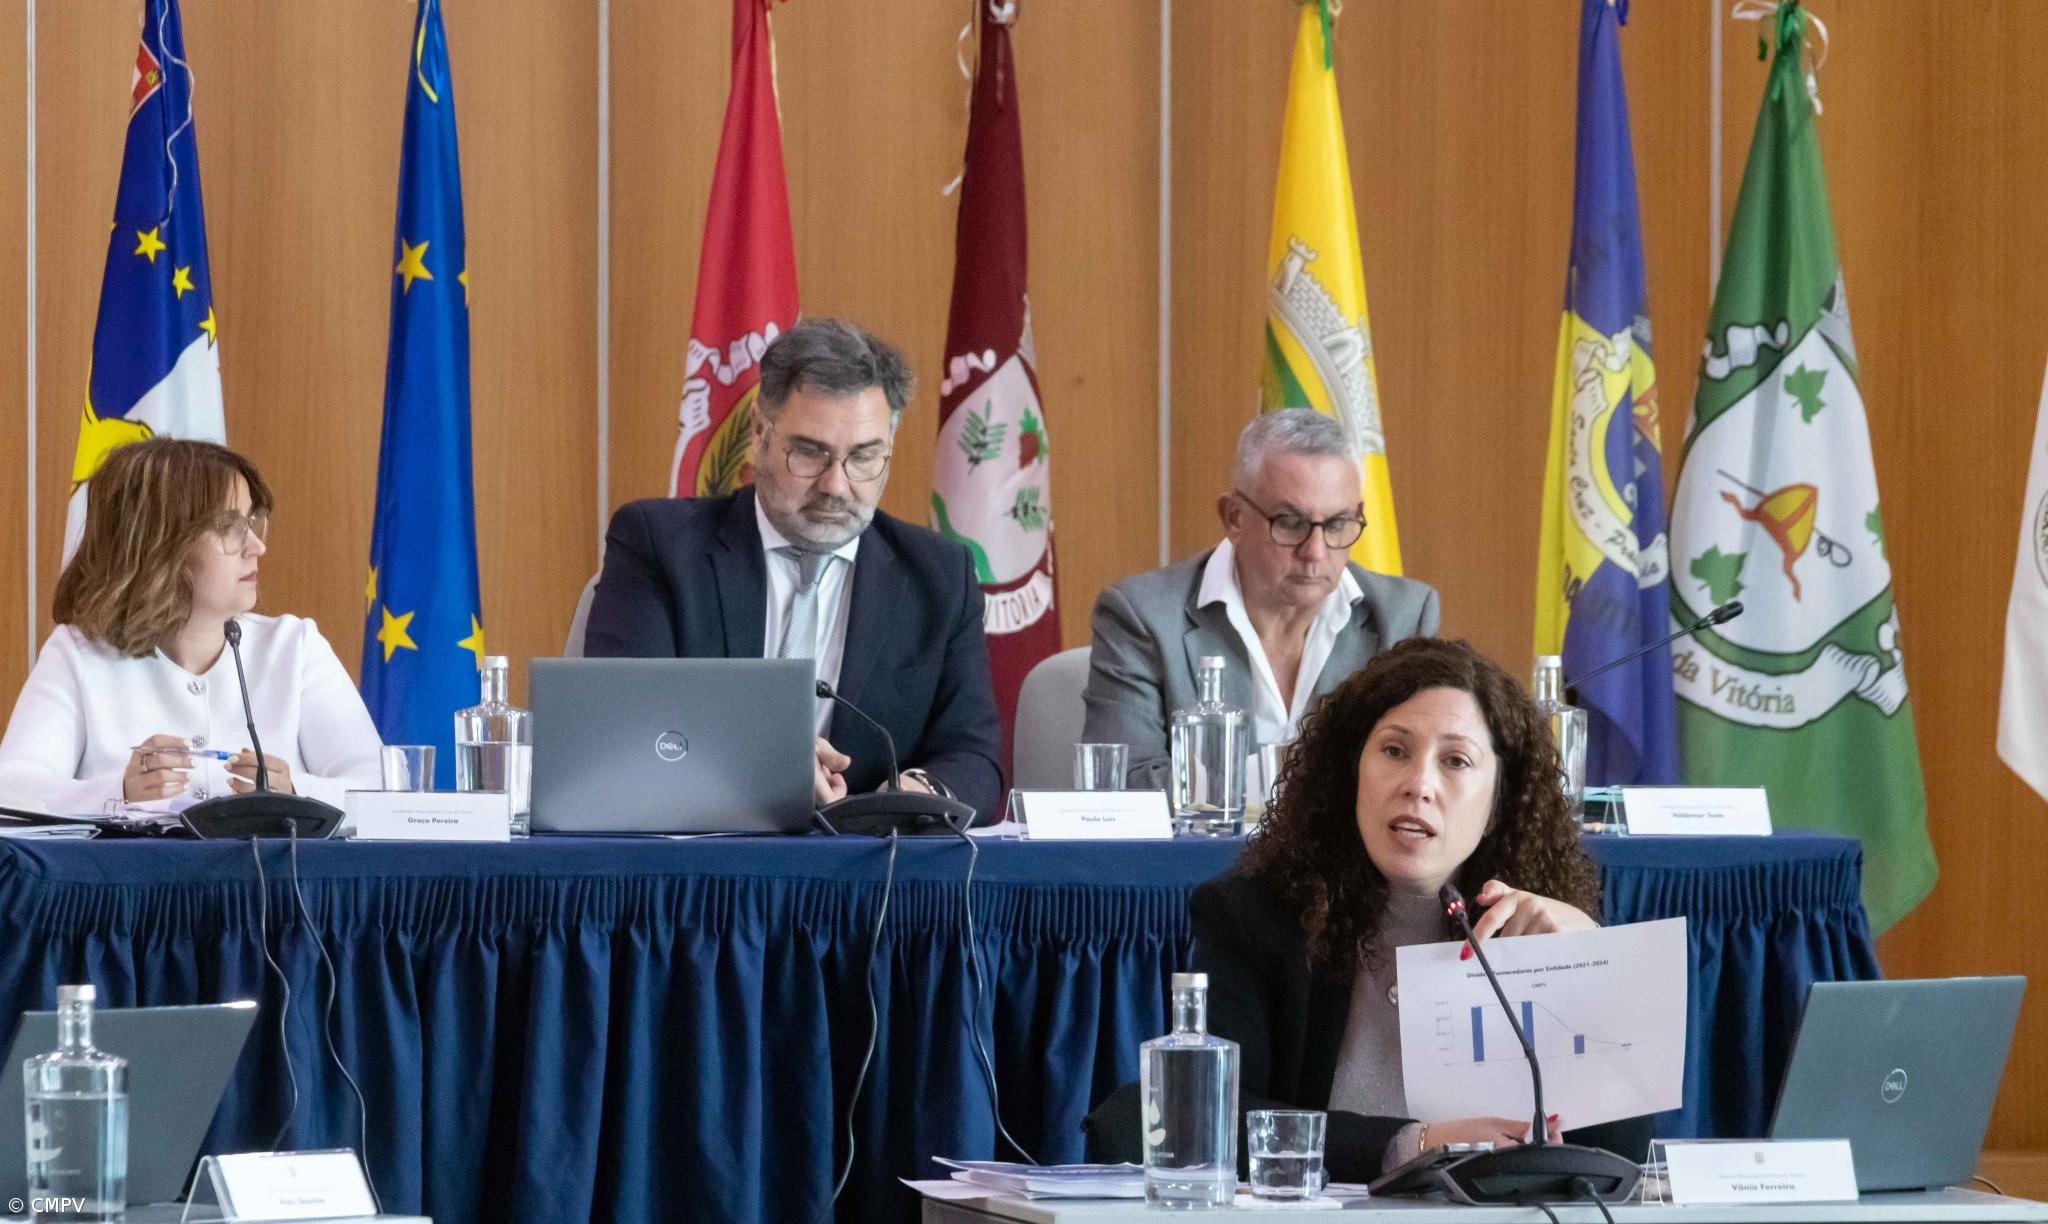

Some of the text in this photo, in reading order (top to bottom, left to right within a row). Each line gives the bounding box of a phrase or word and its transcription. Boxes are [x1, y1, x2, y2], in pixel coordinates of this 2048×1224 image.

[1673, 649, 1795, 713] da Vitória
[432, 816, 459, 825] Pereira
[1760, 1182, 1796, 1191] Ferreira
